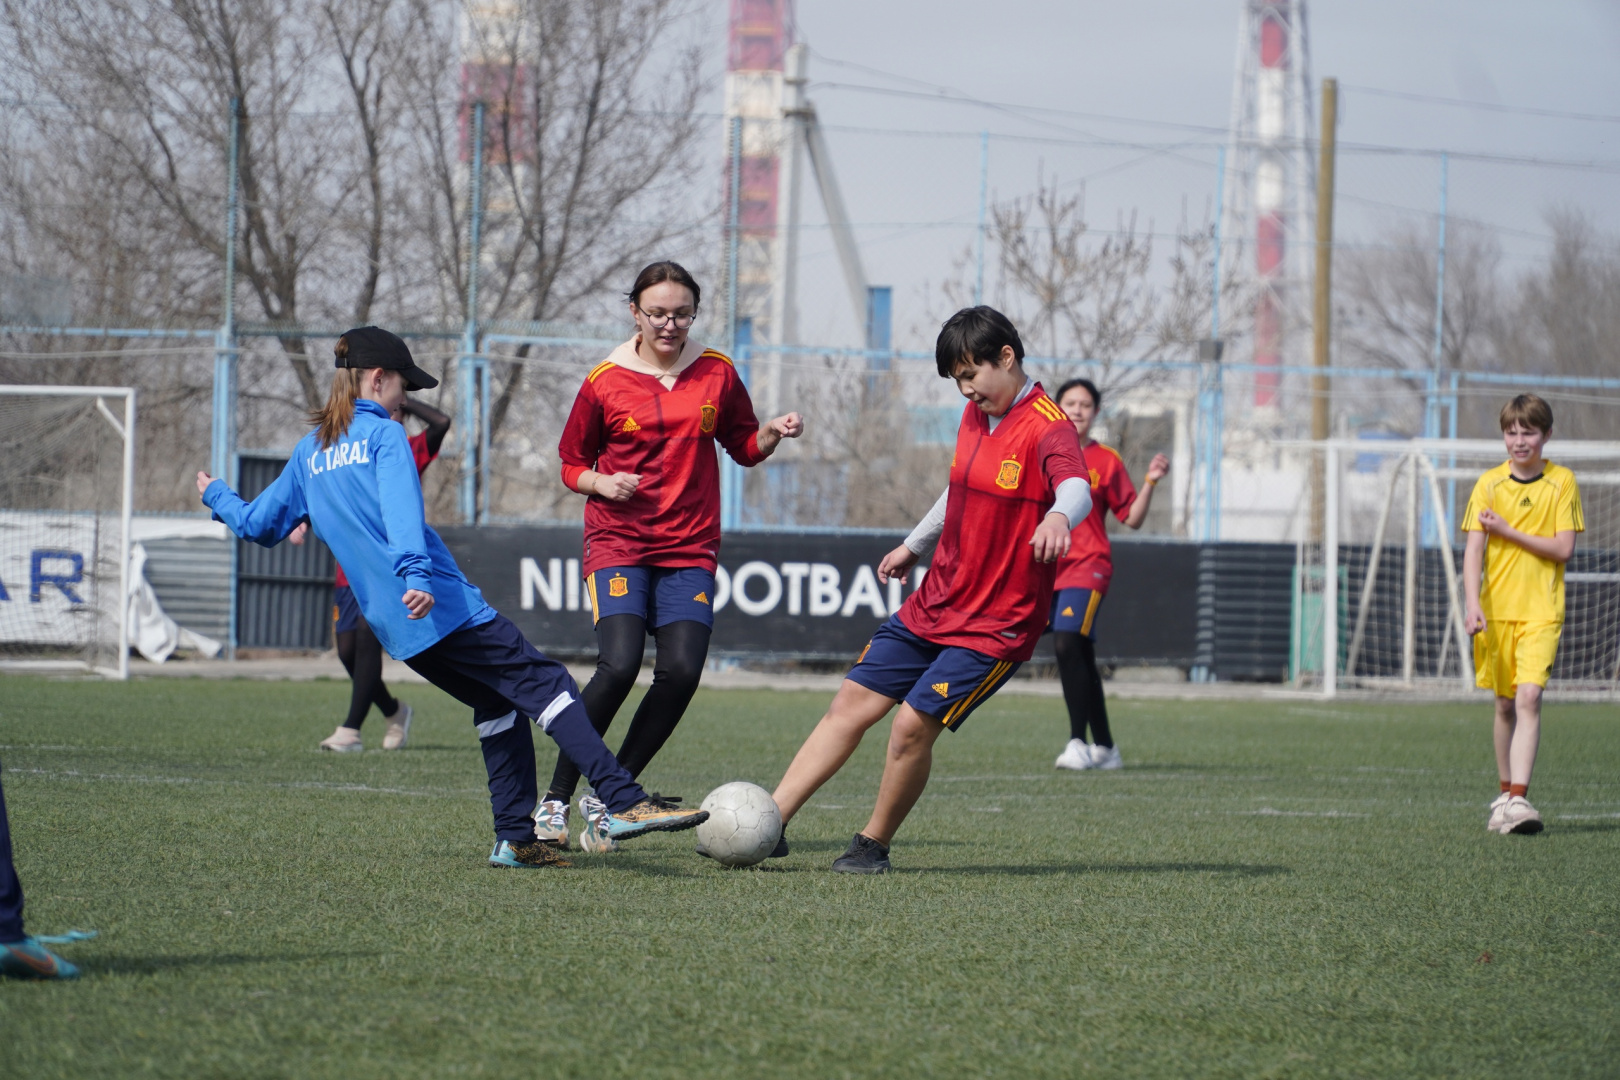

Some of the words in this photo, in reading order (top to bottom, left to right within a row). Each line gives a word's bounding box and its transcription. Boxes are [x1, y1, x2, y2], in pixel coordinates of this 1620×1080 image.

[323, 438, 370, 471] TARAZ
[0, 548, 85, 604] R
[520, 557, 594, 612] NI
